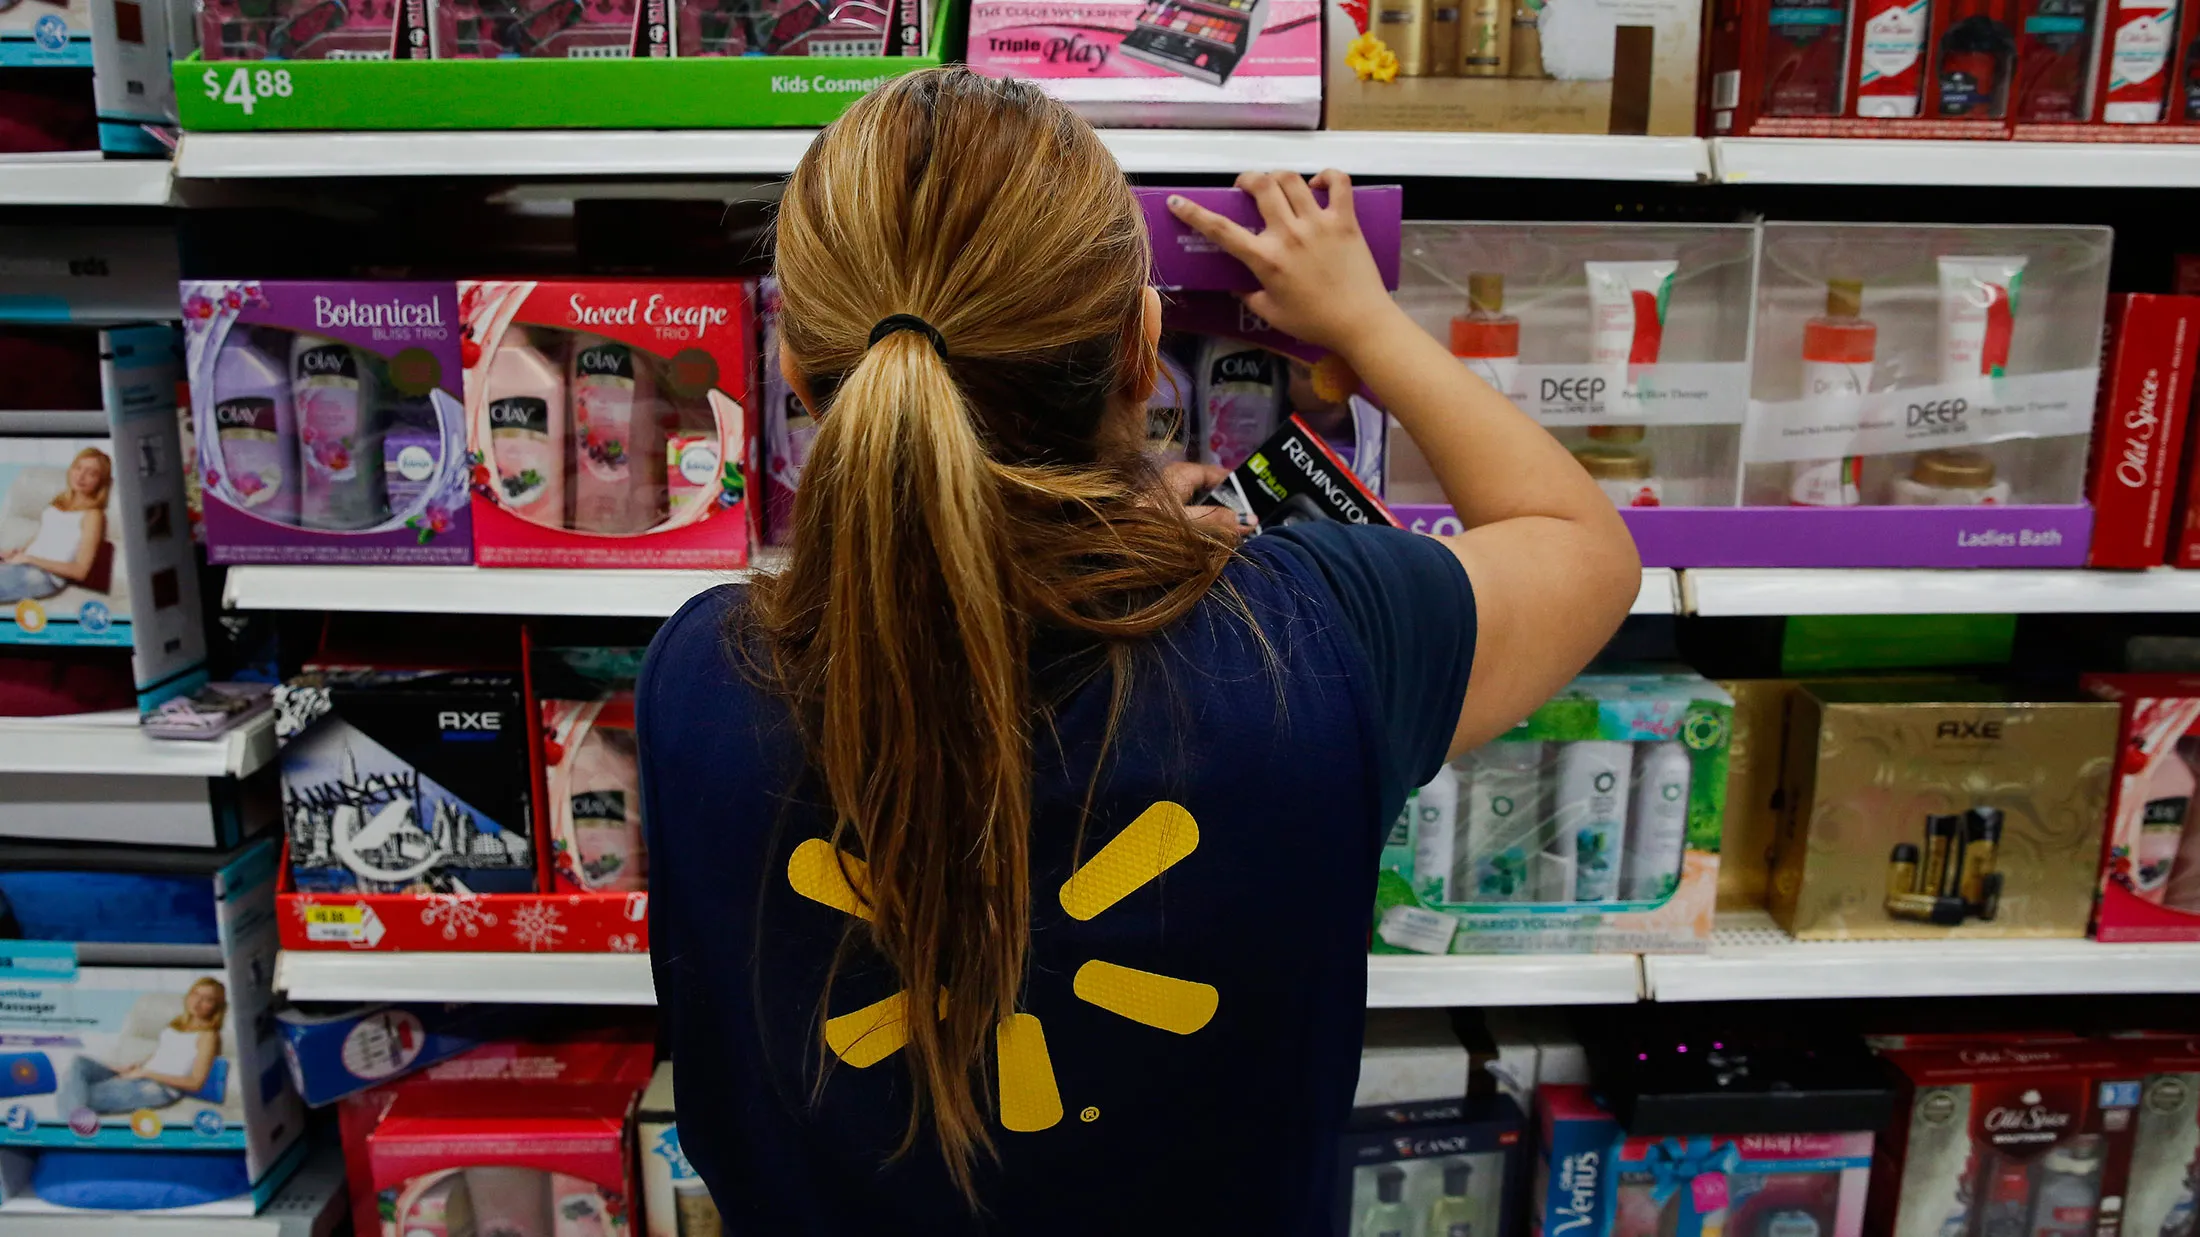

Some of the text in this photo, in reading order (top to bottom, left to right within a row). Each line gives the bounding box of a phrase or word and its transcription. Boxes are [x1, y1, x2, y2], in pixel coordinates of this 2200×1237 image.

[989, 32, 1111, 72] Triple Play
[771, 76, 809, 93] Kids
[313, 294, 446, 328] Botanical
[567, 293, 730, 339] Sweet Escape
[415, 327, 448, 340] TRIO
[654, 327, 690, 341] TRIO
[1541, 377, 1606, 401] DEEP
[1906, 399, 1968, 427] DEEP
[2116, 438, 2149, 488] Old
[1957, 528, 2062, 547] Ladies Bath
[438, 711, 503, 730] AXE
[1936, 721, 2002, 739] AXE
[1553, 1151, 1600, 1236] Venus
